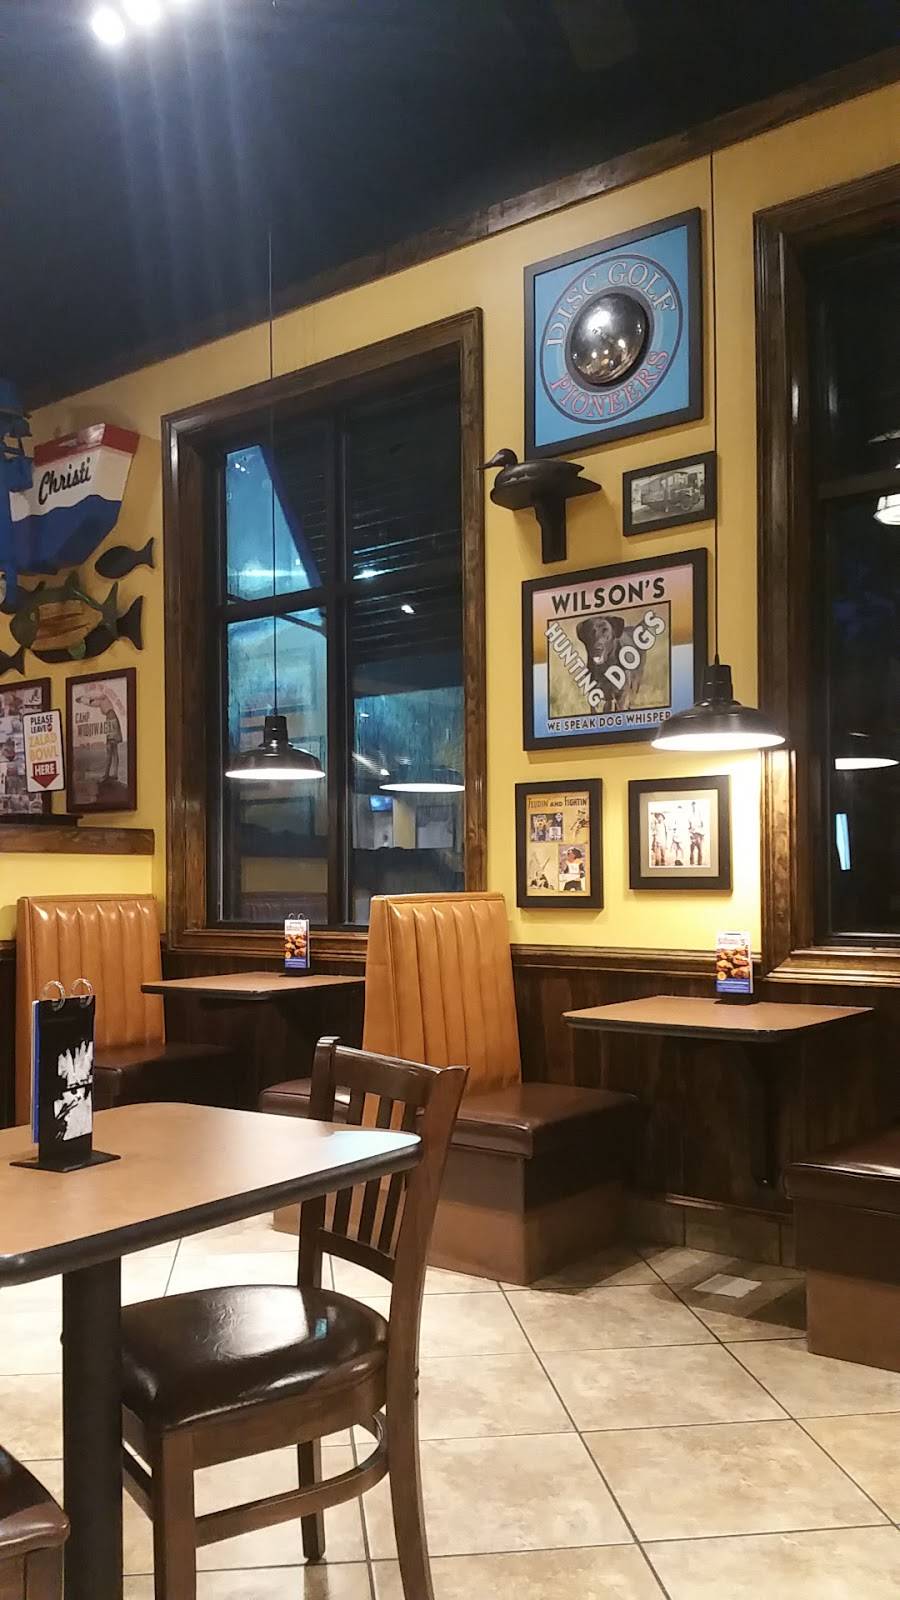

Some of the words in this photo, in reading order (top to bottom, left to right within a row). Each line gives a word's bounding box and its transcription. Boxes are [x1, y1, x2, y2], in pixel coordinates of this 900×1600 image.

[546, 272, 598, 346] DISC
[607, 261, 677, 313] GOLF
[550, 351, 670, 417] PIONEERS
[38, 457, 91, 505] Christi
[552, 577, 665, 614] WILSON'S
[544, 622, 606, 707] HUNTING
[604, 609, 666, 690] DOGS
[30, 714, 53, 725] PLEASE
[30, 725, 47, 734] LEAVE
[547, 721, 561, 731] WE
[564, 718, 596, 731] SPEAK
[599, 716, 622, 728] DOG
[29, 744, 59, 761] BOWL
[34, 763, 56, 776] HERE
